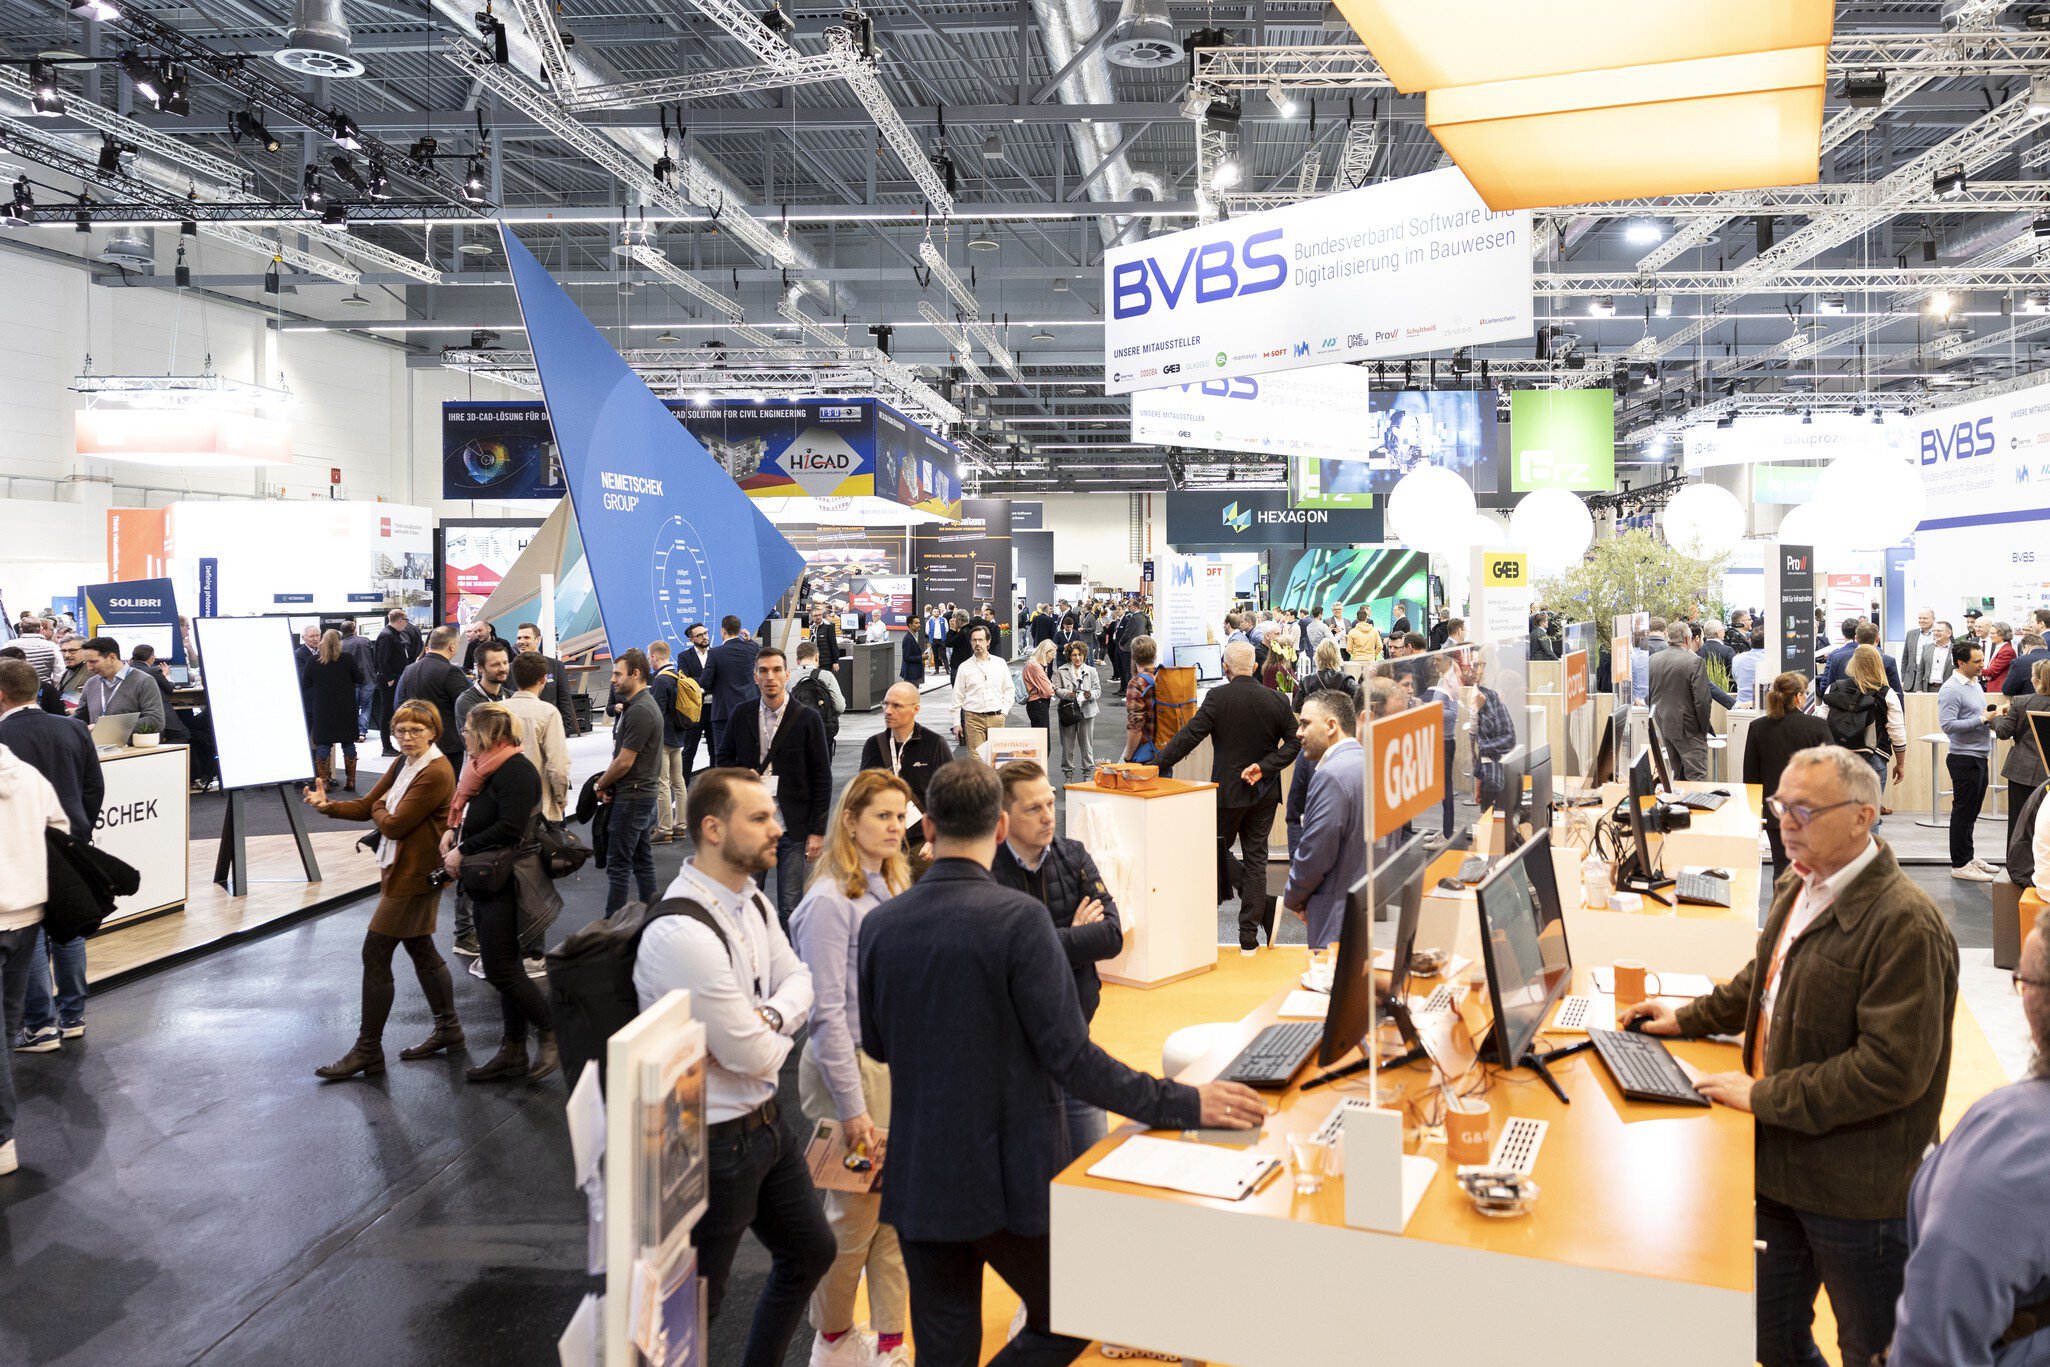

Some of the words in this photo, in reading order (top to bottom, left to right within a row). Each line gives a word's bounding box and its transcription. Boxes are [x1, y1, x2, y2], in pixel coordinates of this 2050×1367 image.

[1295, 223, 1404, 260] Bundesverband
[1410, 208, 1480, 236] Software
[1295, 252, 1399, 287] Digitalisierung
[1405, 247, 1424, 265] im
[1430, 230, 1515, 260] Bauwesen
[1113, 228, 1288, 320] BVBS
[1114, 346, 1141, 358] UNSERE
[1142, 335, 1200, 353] MITAUSSTELLER
[1233, 353, 1258, 361] mamasys
[1140, 368, 1158, 377] COSOBA
[1163, 364, 1181, 374] GAEB
[448, 413, 465, 421] IHRE
[466, 411, 524, 421] 3D-CAD-LÖSUNG
[525, 411, 540, 421] FÜR
[671, 410, 686, 419] CAD
[687, 410, 723, 419] SOLUTION
[724, 410, 738, 419] FOR
[739, 410, 758, 419] CIVIL
[760, 409, 807, 418] ENGINEERING
[1139, 410, 1161, 418] UNSERE
[1162, 411, 1206, 422] MITAUSSTELLER
[2011, 408, 2028, 419] UNSERE
[1921, 416, 1995, 466] BVBS
[601, 471, 664, 496] NEMETSCHEK
[1257, 511, 1328, 523] HEXAGON
[2012, 551, 2035, 562] BVBS
[1206, 567, 1222, 576] OFT
[1492, 561, 1519, 578] GAEB
[204, 565, 212, 590] Defining
[109, 598, 162, 608] SOLIBRI
[1384, 723, 1435, 810] G&W
[94, 798, 158, 830] SCHEK
